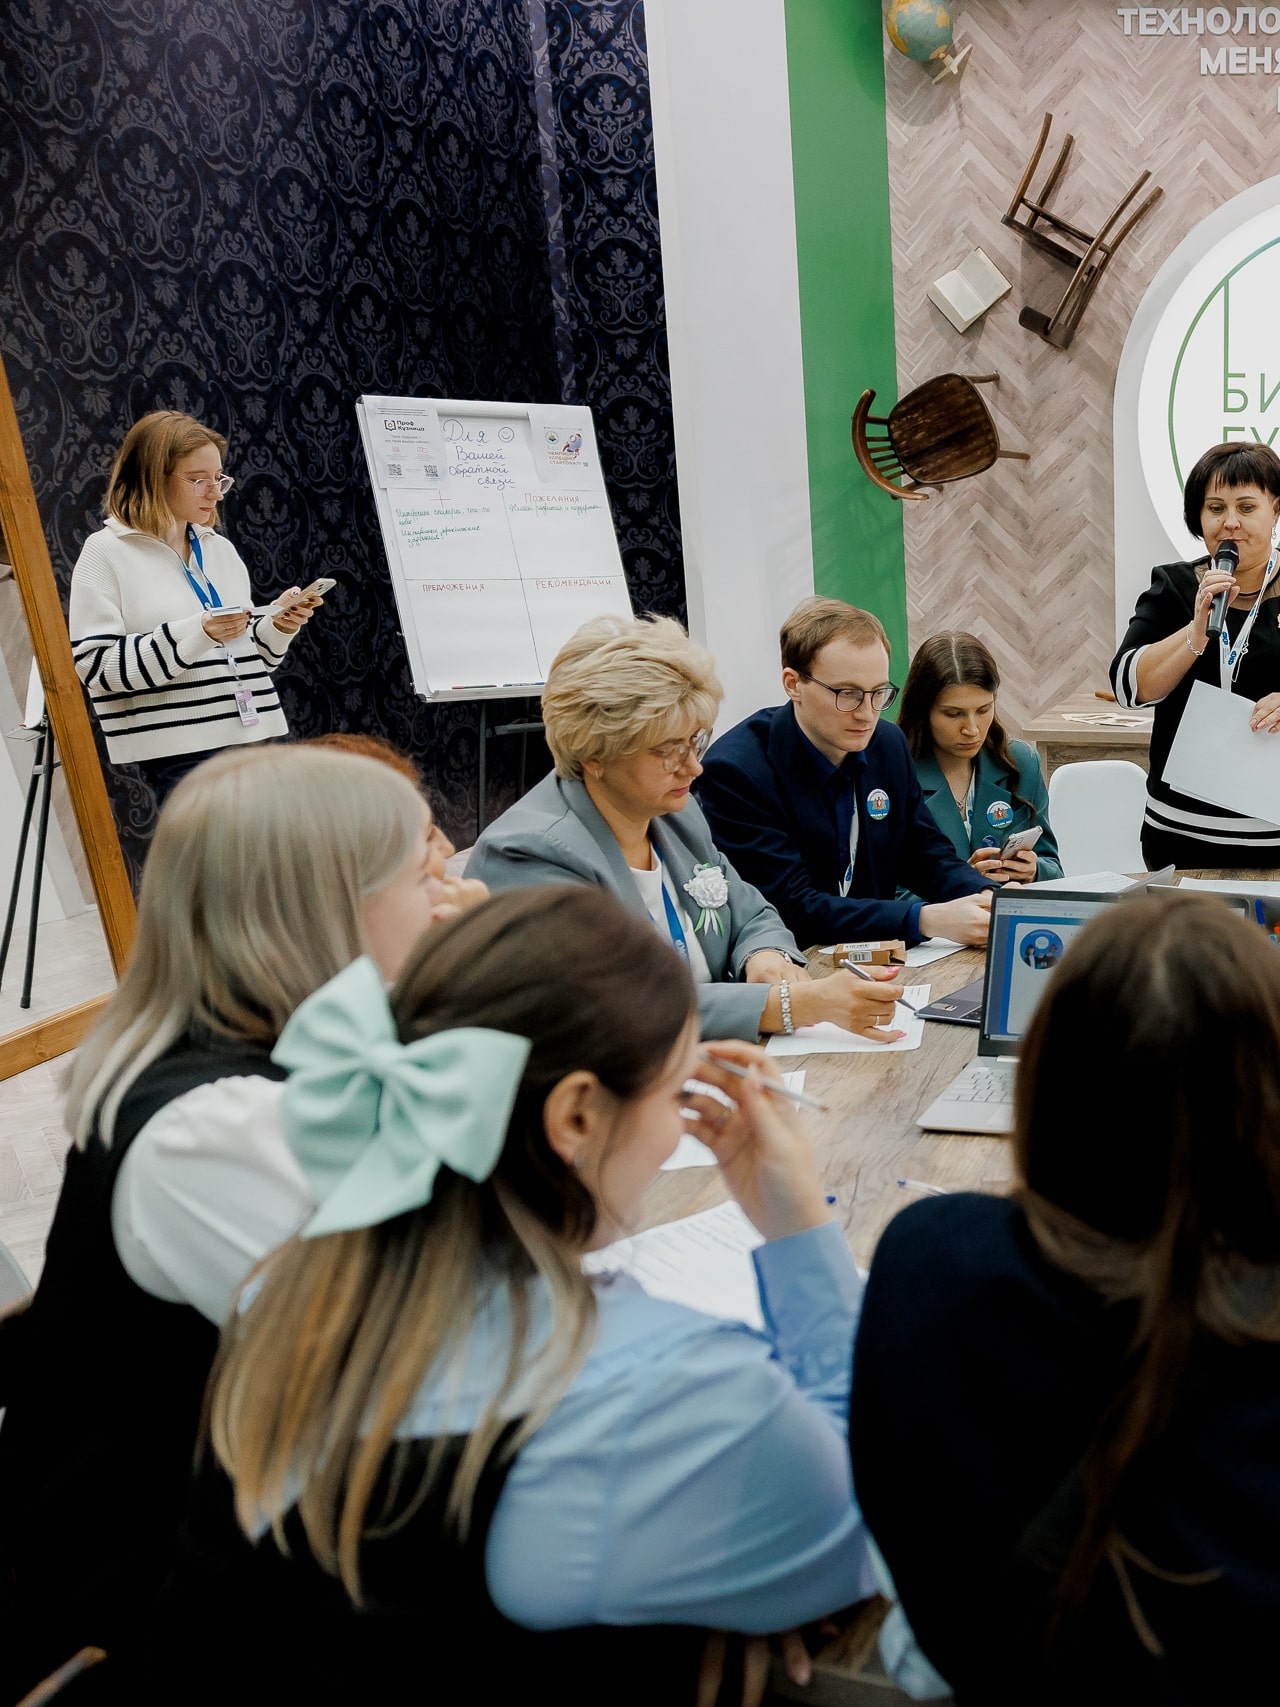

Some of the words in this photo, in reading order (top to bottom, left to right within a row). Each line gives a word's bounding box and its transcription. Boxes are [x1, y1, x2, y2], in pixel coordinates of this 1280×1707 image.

[443, 419, 488, 444] Для
[456, 445, 505, 461] Вашей
[422, 583, 485, 593] ПРЕДЛОЖЕНИЯ
[536, 579, 612, 589] РЕКОМЕНДАЦИИ
